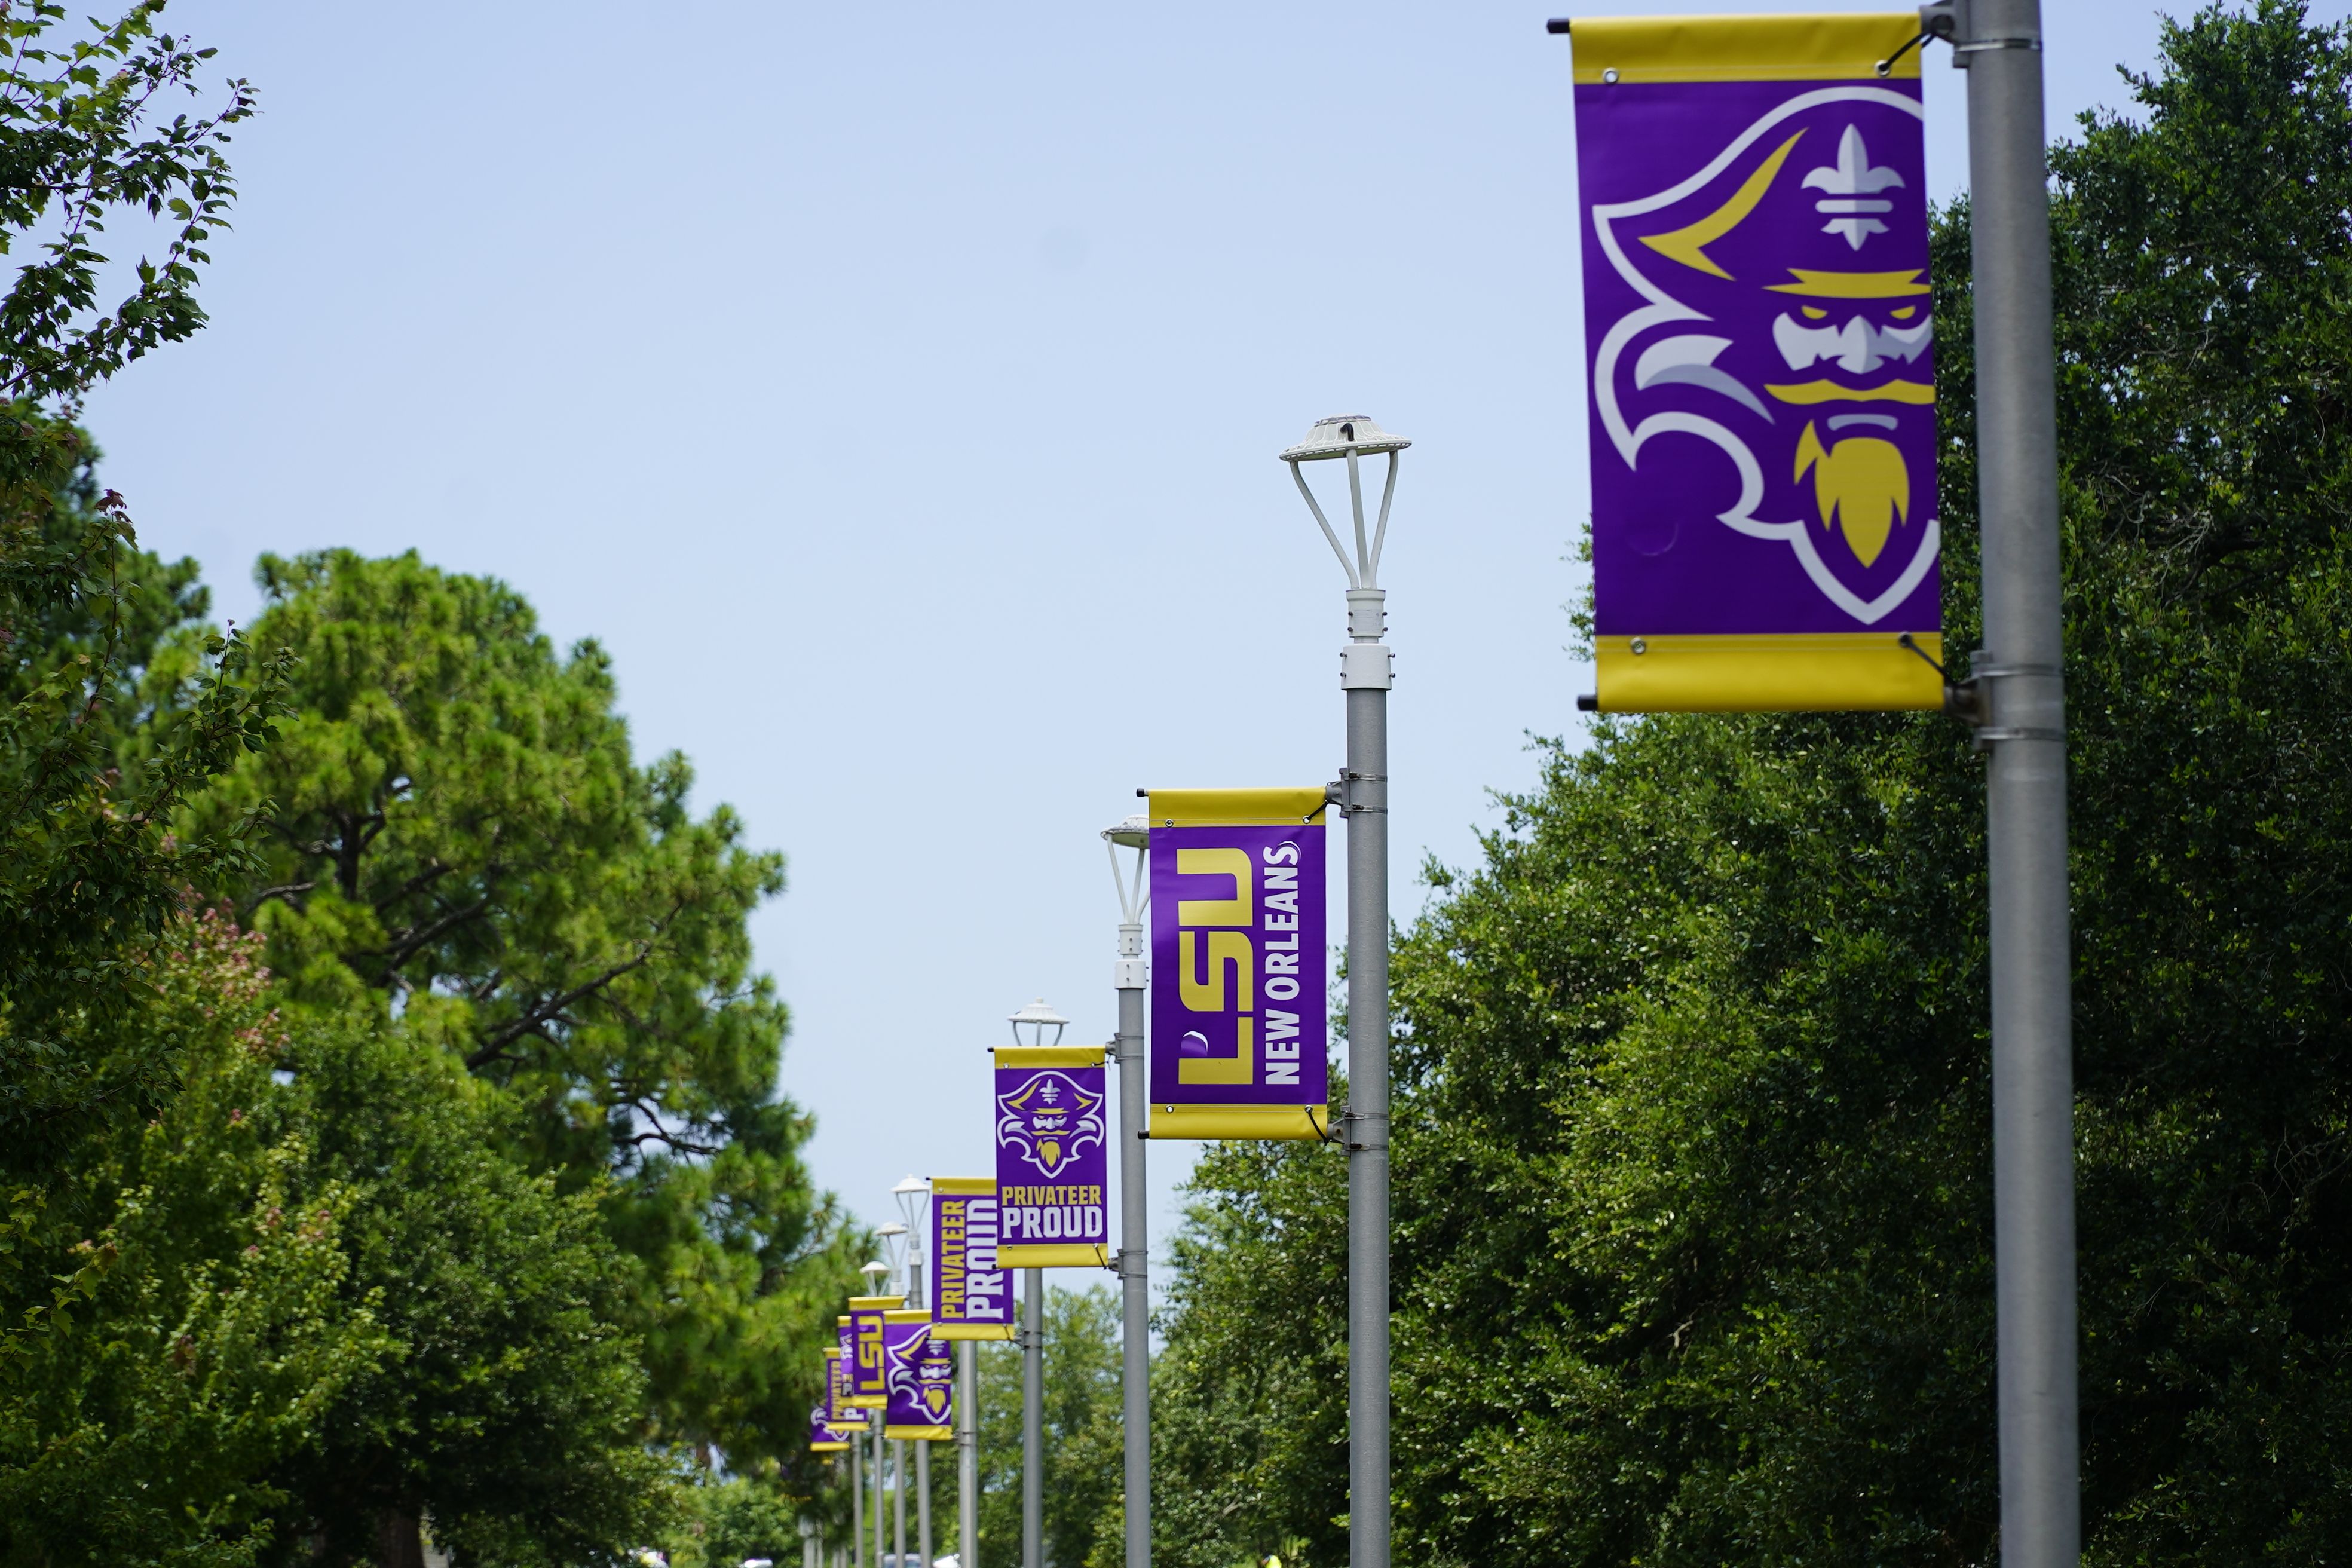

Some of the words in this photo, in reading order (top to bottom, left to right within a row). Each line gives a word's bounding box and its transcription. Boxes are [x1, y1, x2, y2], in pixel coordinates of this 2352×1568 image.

[1263, 841, 1300, 1001] ORLEANS
[1177, 848, 1253, 1085] LSU
[1265, 1009, 1300, 1085] NEW
[1002, 1185, 1101, 1206] PRIVATEER
[1002, 1206, 1103, 1239] PROUD
[941, 1200, 965, 1319] PRIVATEER
[858, 1316, 886, 1391] LSU
